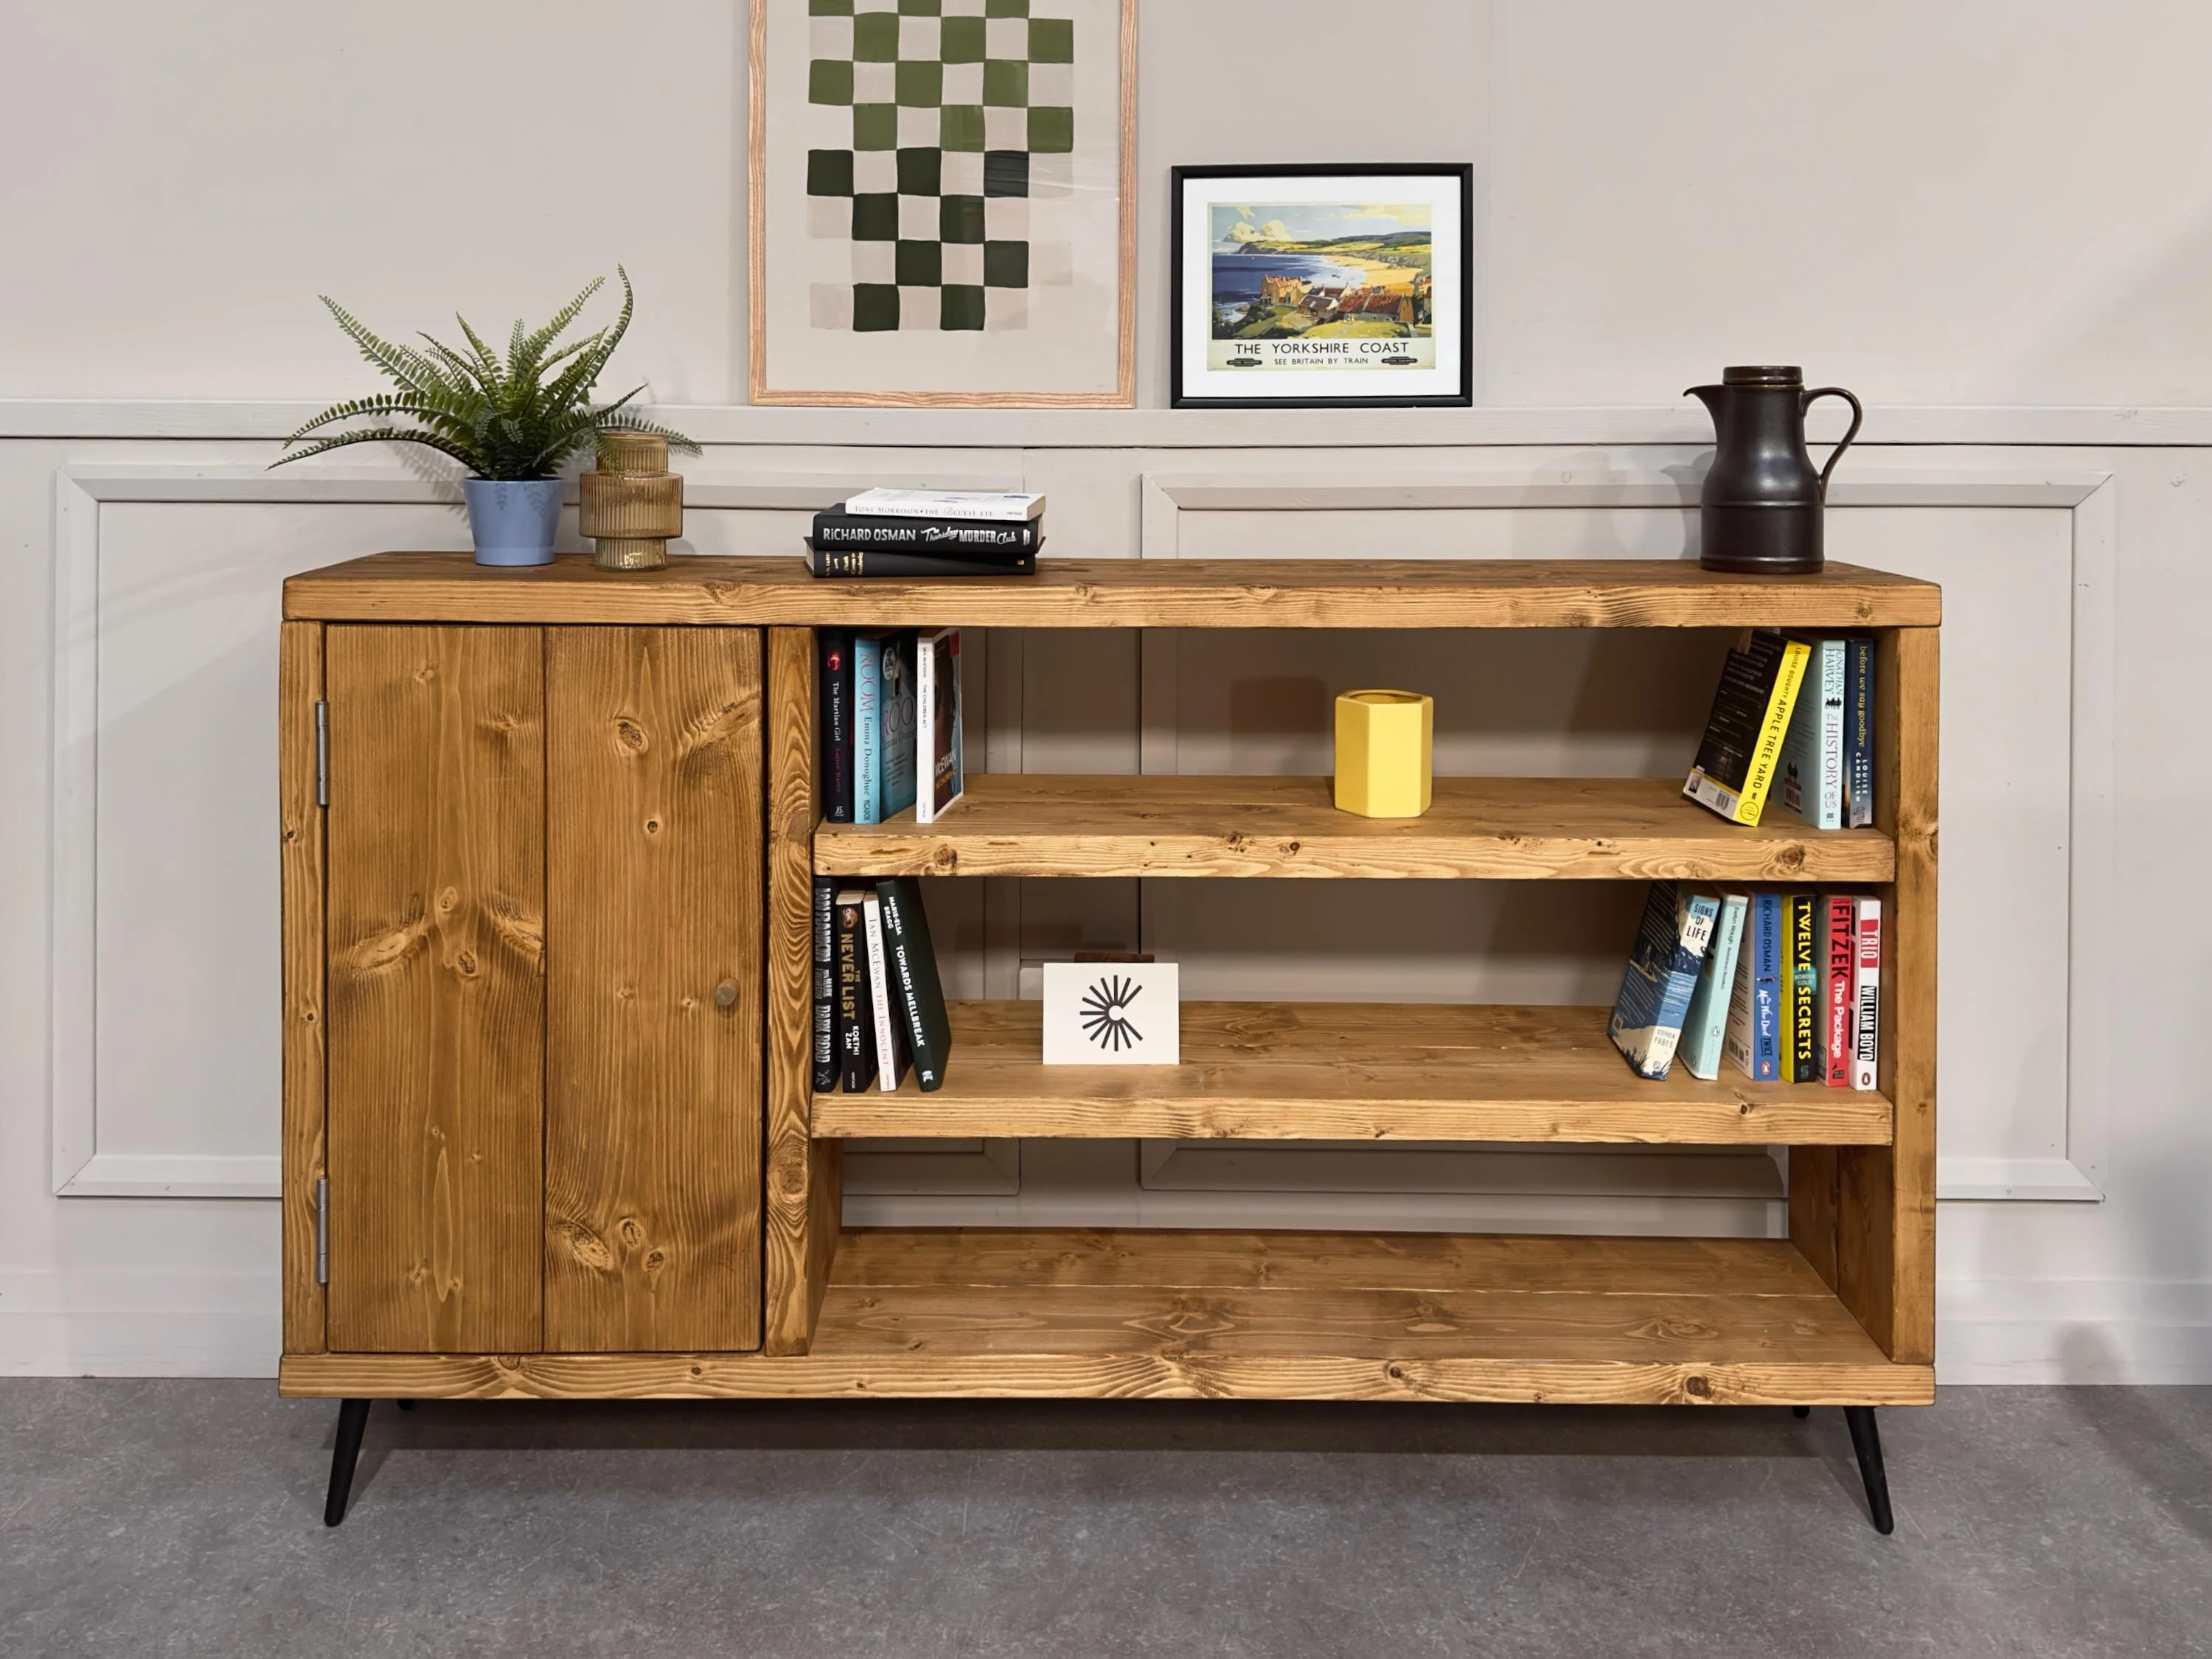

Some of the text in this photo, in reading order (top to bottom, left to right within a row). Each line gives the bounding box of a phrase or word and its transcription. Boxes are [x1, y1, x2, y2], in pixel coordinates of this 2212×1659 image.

[1235, 342, 1408, 354] THE YORKSHIRE COAST
[877, 507, 920, 515] MORRISON
[874, 528, 916, 541] OSMAN
[920, 526, 959, 542] Thursday
[959, 529, 995, 543] MURDER
[997, 532, 1017, 545] Club
[860, 653, 876, 712] ROOM
[1783, 647, 1802, 698] LOUISE DOUGHTY
[1825, 649, 1834, 695] HARVEY
[1857, 646, 1868, 748] before we say goodbye
[1753, 699, 1787, 789] APPLE TREE YARD
[1826, 723, 1837, 789] HISTORY
[862, 748, 872, 796] Donoghue
[1824, 791, 1837, 799] OF
[1826, 800, 1837, 808] US
[815, 888, 832, 911] IAN
[883, 905, 894, 929] BRAGG
[888, 897, 902, 936] MARIE-ELSA
[1693, 904, 1714, 917] SIGNS
[1696, 916, 1705, 926] OF
[815, 911, 832, 961] RANKIN
[869, 919, 877, 937] IAN
[1686, 926, 1708, 942] LIFE
[1728, 906, 1740, 945] Evelyn Waugh
[1798, 901, 1811, 972] TWELVE
[1832, 905, 1850, 979] FITZEK
[1861, 930, 1878, 959] TRIO
[841, 933, 855, 1019] NEVER LIST
[1762, 939, 1773, 972] OSMAN
[823, 978, 832, 997] MARK
[896, 945, 925, 1047] TOWARDS MELLBREAK
[1834, 980, 1845, 1004] The
[815, 1004, 831, 1063] DARK ROAD
[879, 1016, 888, 1065] INNOCENT
[1756, 989, 1773, 1056] Man Who Died TWICE
[1798, 987, 1812, 1060] SECRETS
[1832, 1006, 1845, 1059] Package
[1860, 987, 1876, 1060] WILLIAM BOYD
